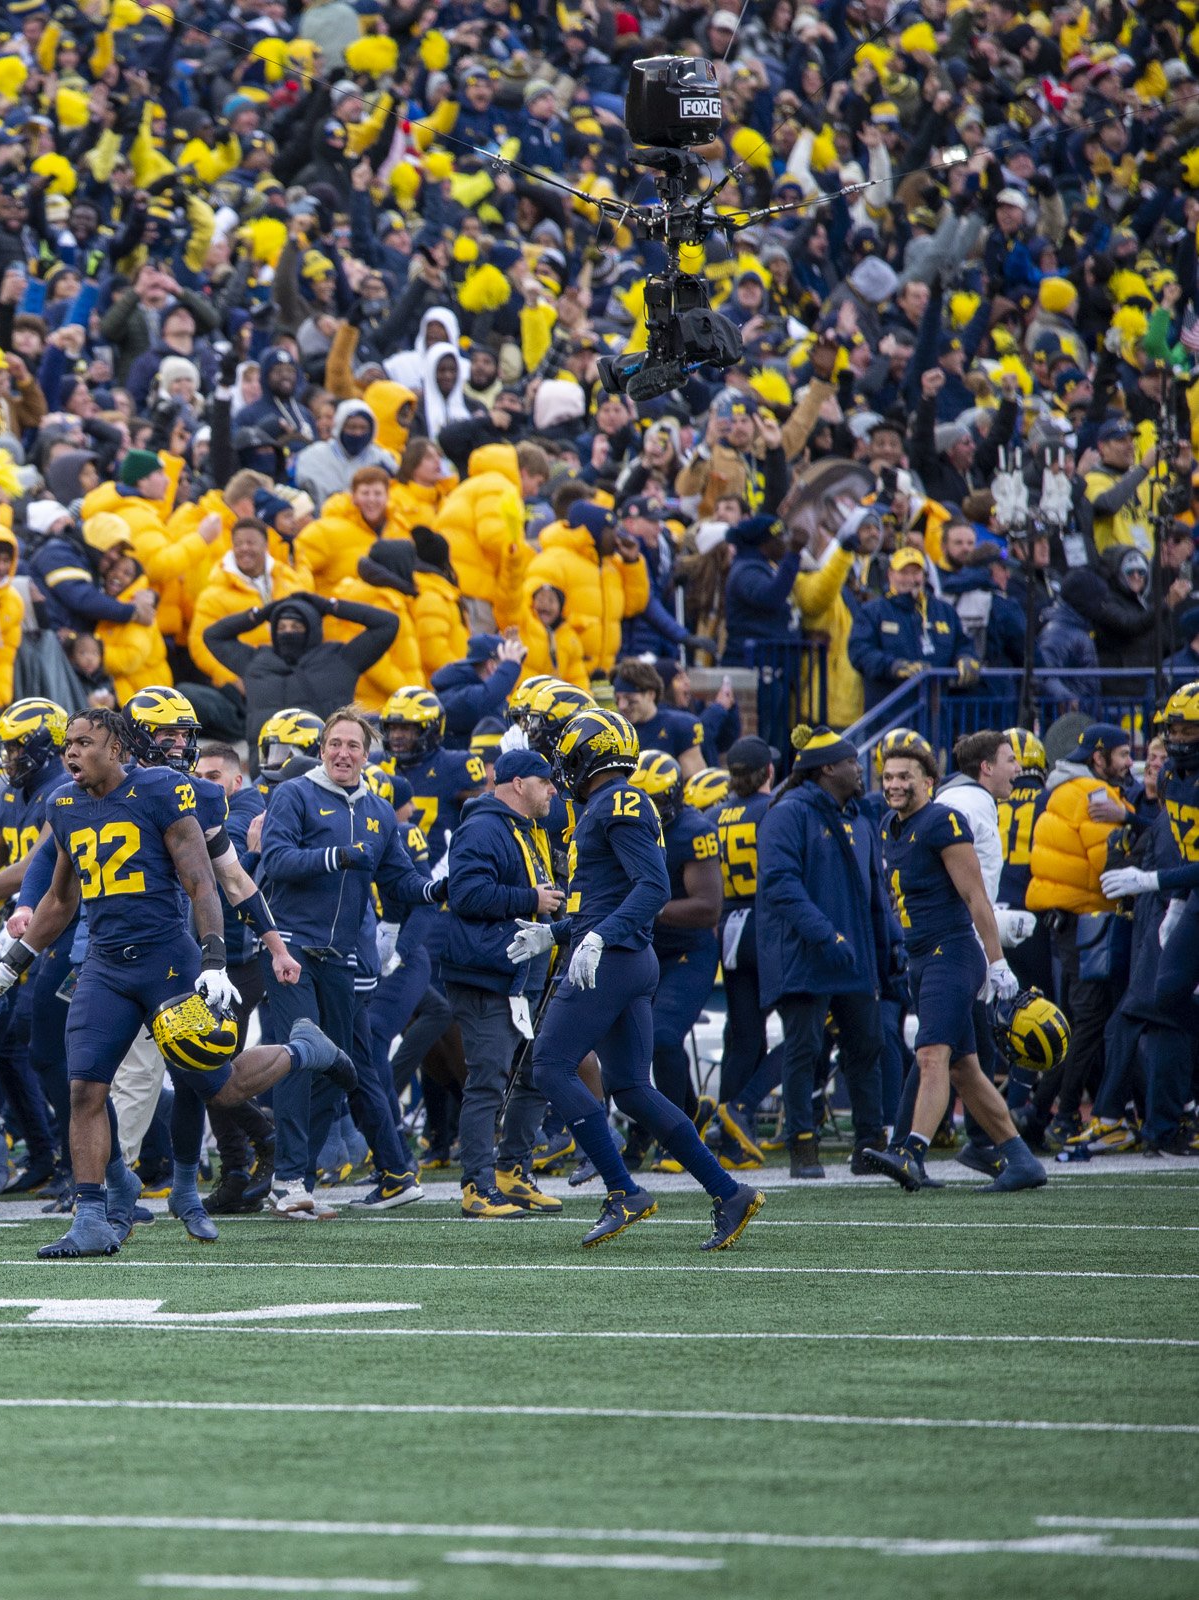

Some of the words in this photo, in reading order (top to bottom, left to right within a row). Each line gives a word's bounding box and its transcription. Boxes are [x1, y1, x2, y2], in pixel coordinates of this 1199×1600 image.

[682, 100, 709, 115] FOX
[174, 783, 197, 812] 32
[612, 790, 641, 817] 12
[366, 816, 380, 834] M
[948, 812, 963, 838] 1
[406, 826, 428, 852] 41
[692, 832, 719, 861] 96
[69, 821, 147, 900] 32
